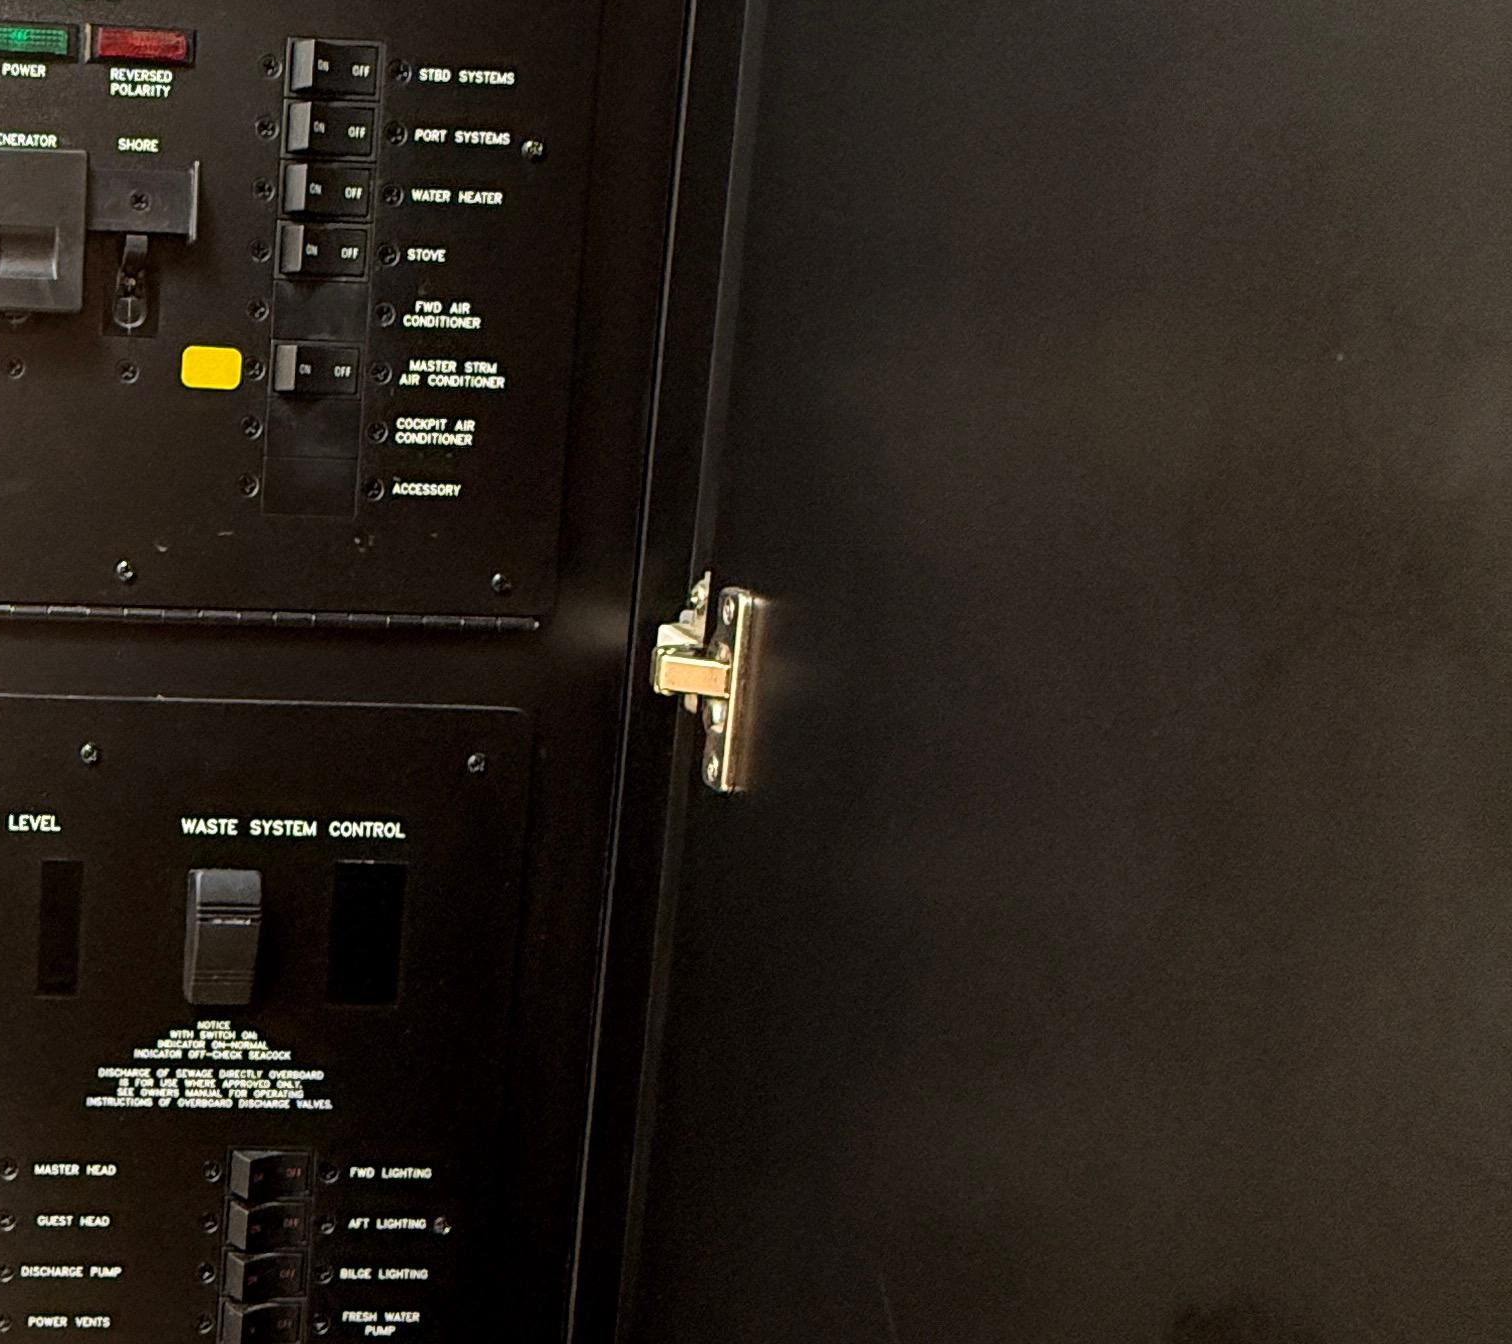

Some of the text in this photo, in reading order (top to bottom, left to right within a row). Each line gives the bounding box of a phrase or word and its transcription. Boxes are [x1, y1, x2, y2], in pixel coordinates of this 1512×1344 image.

[2, 63, 46, 77] POWER
[110, 68, 172, 83] REVERSED
[420, 68, 514, 84] STBD SYSTEMS
[111, 83, 170, 97] POLARITY
[415, 129, 510, 145] PORT SYSTEMS
[119, 138, 158, 152] SHORE
[412, 189, 502, 204] WATER HEATER
[408, 249, 445, 262] STOVE
[415, 301, 470, 314] FWD AIR
[403, 315, 481, 329] CONDITIONER
[410, 360, 497, 373] MASTER STRM
[399, 374, 505, 388] AIR CONDITIONER
[396, 418, 475, 431] COCKPIT AIR
[395, 432, 472, 445] CONDITIONER
[393, 483, 461, 496] ACCESSORY
[9, 814, 61, 831] LEVEL
[182, 818, 405, 838] WASTE SYSTEM CONTROL
[197, 1021, 230, 1030] NOTICE
[98, 1068, 324, 1080] DISCHARGE OF SEWAGE DIRECTLY OVERBOARD
[117, 1087, 304, 1098] SEE OWNERS MANUAL FOR OPERATING
[34, 1164, 116, 1175] MASTER HEAD
[350, 1167, 432, 1178] FWD LIGHTING
[37, 1216, 110, 1226] GUEST HEAD
[348, 1218, 426, 1229] AFT LIGHTING
[21, 1266, 121, 1277] DISCHARGE PUMP
[340, 1268, 428, 1279] BILGE LIGHTING
[28, 1316, 110, 1327] POWER VENTS
[342, 1311, 420, 1322] FRESH WATER
[365, 1325, 395, 1336] PUMP
